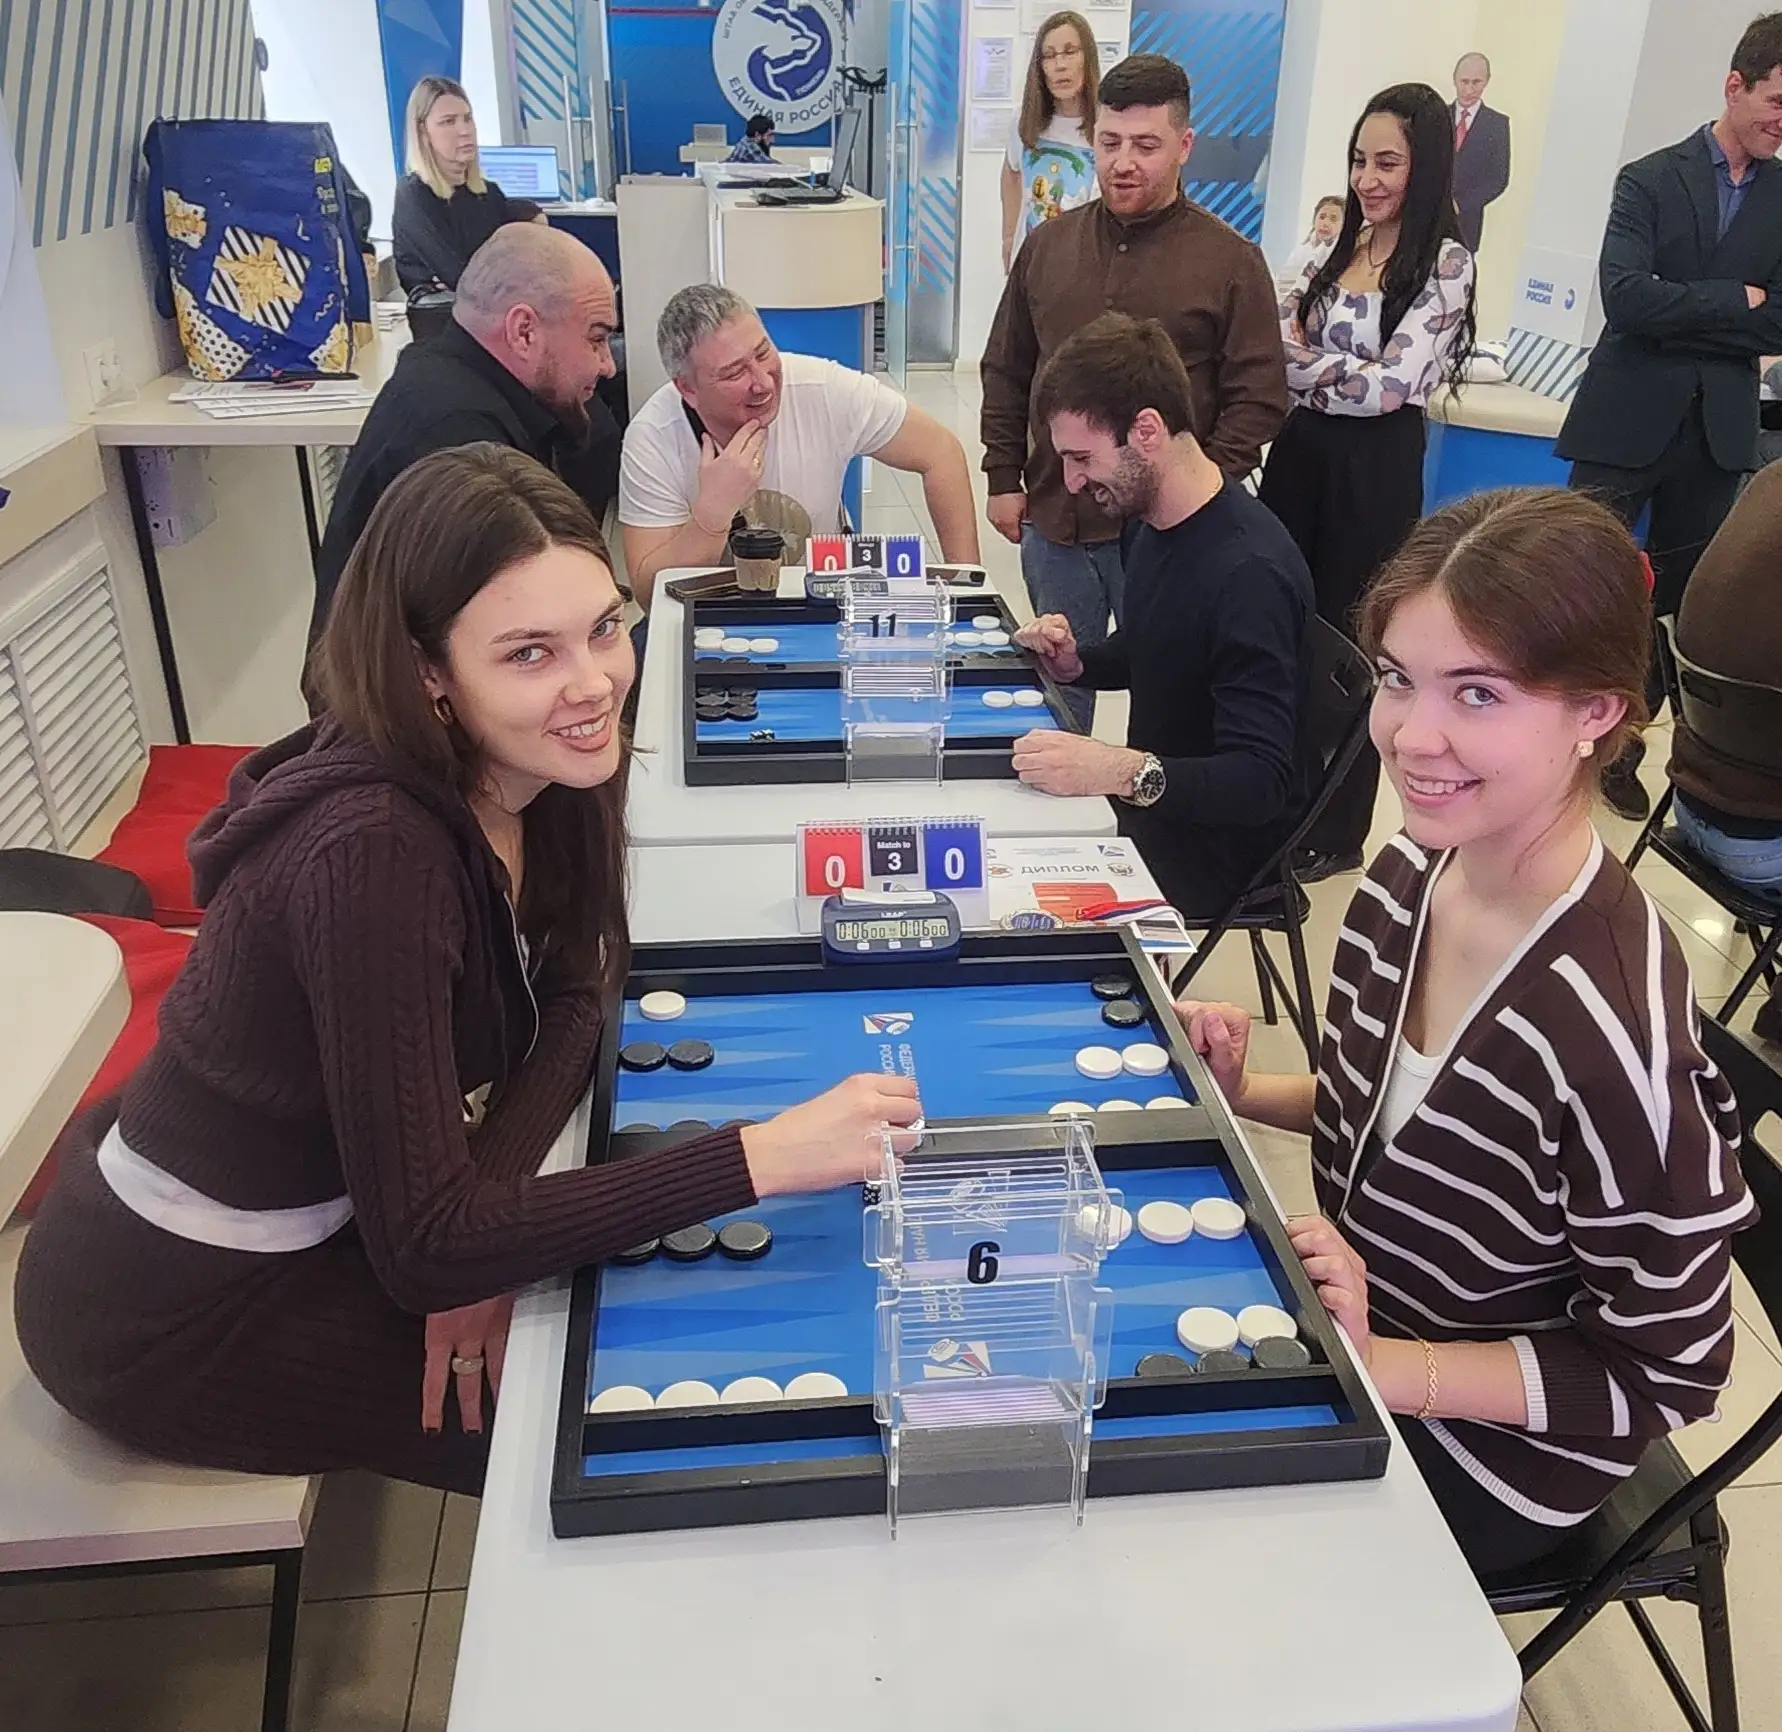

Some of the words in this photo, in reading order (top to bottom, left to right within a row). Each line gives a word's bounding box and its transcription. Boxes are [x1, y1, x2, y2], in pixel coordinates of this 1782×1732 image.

[728, 76, 784, 123] ЕДИНАЯ
[789, 80, 842, 124] РОССИЯ
[862, 549, 872, 562] 3
[896, 553, 910, 574] 0
[869, 613, 897, 638] 11
[876, 841, 901, 850] Match
[902, 841, 911, 849] to
[825, 856, 846, 888] 0
[888, 852, 902, 871] 3
[944, 847, 965, 881] 0
[1021, 864, 1100, 875] ДИПЛОМ
[966, 1241, 1001, 1285] 6
